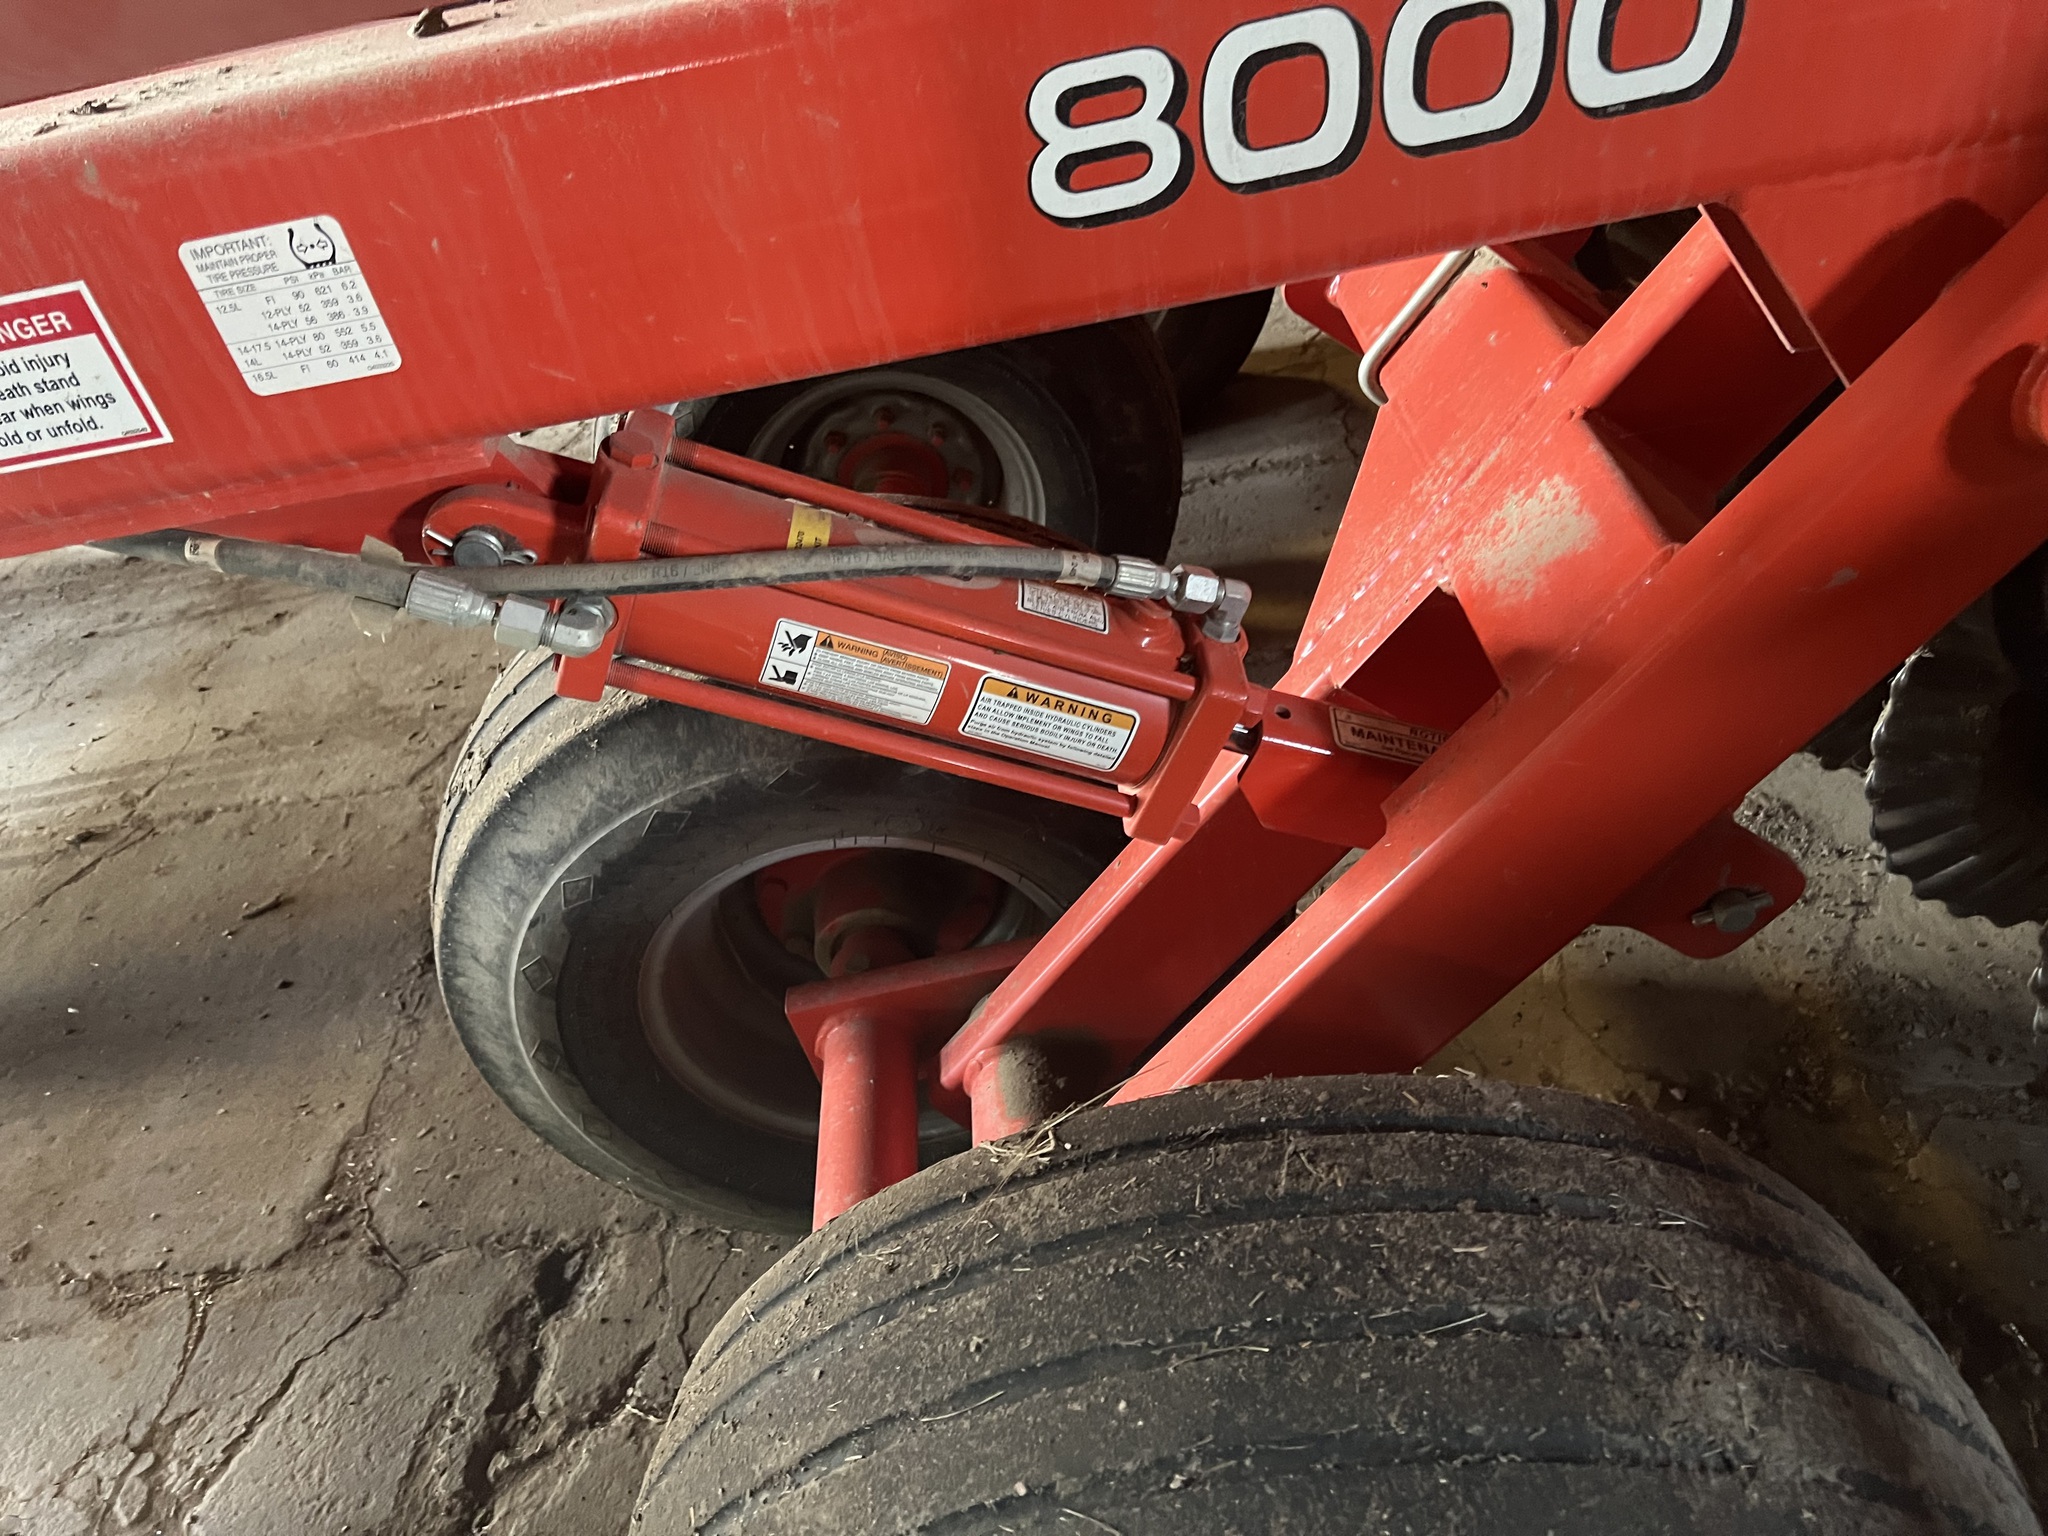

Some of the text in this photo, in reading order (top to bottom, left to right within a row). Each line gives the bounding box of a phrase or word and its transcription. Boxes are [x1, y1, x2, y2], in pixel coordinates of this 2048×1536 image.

[1027, 0, 1743, 228] 8000
[190, 235, 272, 261] IMPORTANT:
[196, 250, 277, 273] MAINTAIN PROPER
[206, 262, 279, 284] TIRE PRESSURE
[214, 288, 235, 298] TIRE
[236, 284, 256, 294] SIZE
[283, 276, 299, 285] PSI
[332, 265, 352, 276] BAR
[216, 303, 242, 315] 12.5L
[292, 290, 305, 301] 90
[261, 306, 291, 320] 12-PLY
[298, 303, 312, 313] 52
[0, 311, 72, 344] NGER
[268, 318, 298, 332] 14-PLY
[275, 334, 306, 348] 14-PLY
[334, 326, 353, 337] 552
[0, 352, 71, 377] oid injury
[244, 358, 262, 368] 14L
[282, 347, 312, 361] 14-PLY
[318, 344, 332, 354] 52
[348, 354, 366, 364] 414
[0, 371, 81, 401] eath stand
[0, 392, 117, 425] ar when wings
[0, 431, 24, 448] old
[26, 429, 43, 442] or
[45, 415, 104, 438] unfold.
[837, 641, 878, 658] WARNING
[981, 696, 1117, 738] AIR TRAPPED INSIDE HYDRAULIC CYLINDERS
[1026, 691, 1112, 724] WARNING
[974, 711, 988, 720] AND
[989, 714, 1012, 726] CAUSE
[1011, 721, 1039, 733] SERIOUS
[1040, 728, 1063, 739] BODILY
[1063, 735, 1086, 745] INJURY
[977, 704, 1109, 744] CAN ALLOW IMPLEMENT OR WINGS TO FALL
